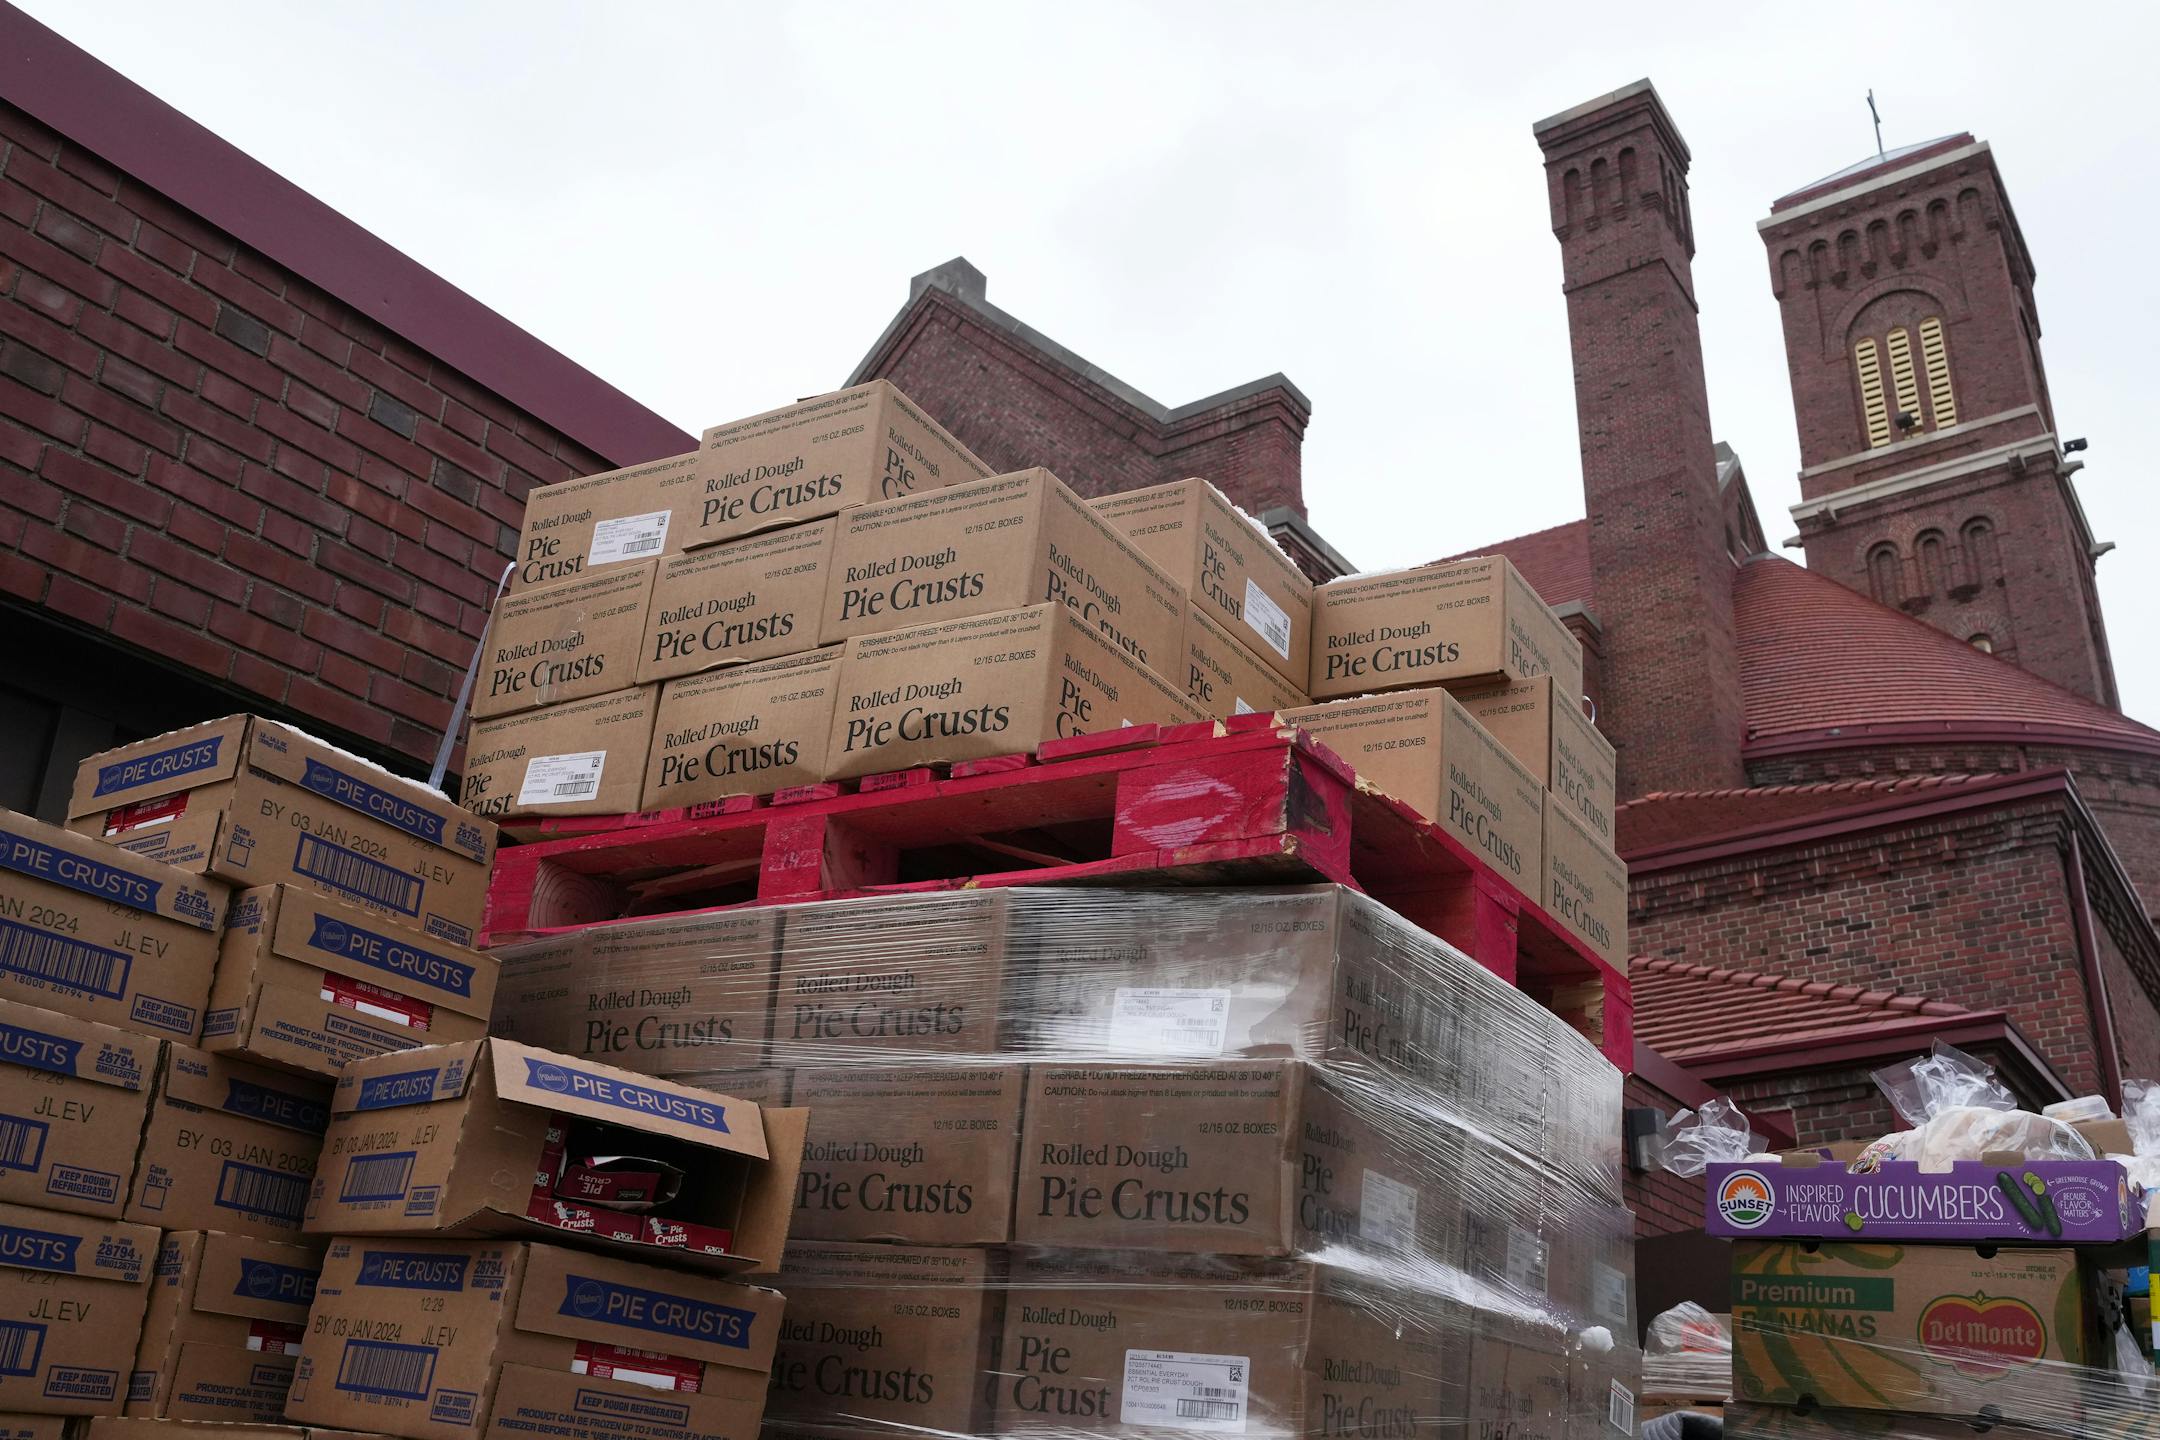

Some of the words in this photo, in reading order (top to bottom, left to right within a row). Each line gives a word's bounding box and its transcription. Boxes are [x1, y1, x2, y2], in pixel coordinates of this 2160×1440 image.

[812, 434, 828, 444] 12/15
[829, 430, 842, 440] OZ.
[842, 424, 864, 438] BOXES
[706, 468, 750, 494] Rolled
[754, 456, 804, 482] Dough
[700, 494, 744, 528] Pie
[750, 473, 843, 514] Crusts
[531, 514, 560, 532] Rolled
[562, 509, 592, 528] Dough
[527, 536, 561, 561] Pie
[1205, 522, 1224, 551] Rolled
[1225, 540, 1245, 568] Dough
[522, 553, 584, 584] Crust
[845, 562, 896, 584] Rolled
[900, 547, 957, 574] Dough
[1203, 542, 1226, 582] Pie
[1416, 572, 1455, 584] REFRIGERATED
[659, 602, 702, 626] Rolled
[706, 592, 756, 618] Dough
[840, 590, 884, 621] Pie
[889, 570, 984, 611] Crusts
[1200, 570, 1242, 622] Crust
[1436, 602, 1454, 612] 12/15
[1455, 600, 1466, 608] OZ.
[1466, 596, 1490, 606] BOXES
[496, 642, 538, 664] Rolled
[540, 632, 584, 656] Dough
[652, 629, 696, 662] Pie
[702, 611, 794, 651] Crusts
[1328, 630, 1375, 649] Rolled
[1380, 620, 1431, 644] Dough
[974, 656, 992, 666] 12/15
[994, 652, 1008, 664] OZ.
[1009, 649, 1036, 662] BOXES
[1326, 653, 1367, 680] Pie
[1372, 641, 1460, 673] Crusts
[490, 668, 528, 698] Pie
[530, 652, 605, 688] Crusts
[849, 690, 901, 712] Rolled
[904, 678, 962, 706] Dough
[664, 728, 706, 750] Rolled
[709, 715, 760, 740] Dough
[843, 720, 892, 752] Pie
[899, 704, 1010, 742] Crusts
[122, 762, 148, 784] PIE
[150, 744, 213, 776] CRUSTS
[469, 751, 496, 769] Rolled
[496, 744, 526, 762] Dough
[658, 754, 700, 788] Pie
[705, 739, 800, 777] Crusts
[465, 772, 492, 800] Pie
[1451, 764, 1476, 798] Rolled
[1478, 791, 1502, 822] Dough
[336, 779, 366, 804] PIE
[368, 792, 437, 834] CRUSTS
[260, 800, 286, 820] BY
[292, 812, 310, 831] 03
[314, 822, 348, 846] JAN
[350, 835, 388, 862] 2024
[1450, 789, 1474, 836] Pie
[1476, 815, 1521, 876] Crusts
[12, 842, 52, 872] PIE
[58, 859, 148, 902] CRUSTS
[414, 860, 454, 886] JLEV
[176, 891, 210, 910] 28794
[30, 906, 80, 934] 2024
[114, 930, 169, 958] JLEV
[350, 934, 383, 958] PIE
[386, 949, 463, 988] CRUSTS
[140, 1000, 160, 1012] KEEP
[163, 1004, 188, 1019] DOUGH
[588, 990, 635, 1011] Rolled
[640, 985, 691, 1010] Dough
[135, 1008, 190, 1030] REFRIGERATED
[584, 1018, 630, 1054] Pie
[634, 1014, 734, 1050] Crusts
[374, 1082, 388, 1102] PIE
[391, 1076, 432, 1100] CRUSTS
[539, 1072, 566, 1083] Pillsbury
[573, 1076, 613, 1100] PIE
[619, 1088, 716, 1124] CRUSTS
[1200, 1124, 1222, 1134] 12/15
[1225, 1123, 1241, 1134] OZ.
[1243, 1123, 1277, 1134] BOXES
[803, 1142, 858, 1162] Rolled
[864, 1142, 924, 1168] Dough
[1040, 1144, 1108, 1166] Rolled
[1116, 1145, 1188, 1174] Dough
[578, 1174, 612, 1186] CRUST
[581, 1183, 604, 1195] PIE
[797, 1172, 852, 1211] Pie
[858, 1174, 973, 1214] Crusts
[1786, 1184, 1844, 1202] INSPIRED
[2056, 1176, 2088, 1184] GREENHOUSE
[2090, 1178, 2109, 1192] GROWN
[1038, 1176, 1102, 1218] Pie
[1112, 1178, 1248, 1224] Crusts
[1720, 1198, 1773, 1213] SUNSET
[1854, 1185, 2004, 1220] CUCUMBERS
[2060, 1200, 2092, 1210] FLAVOR
[2063, 1192, 2086, 1200] BECAUSE
[560, 1217, 595, 1228] Crusts
[576, 1209, 590, 1218] Pie
[1790, 1204, 1840, 1222] FLAVOR
[2064, 1210, 2089, 1218] MATTERS
[656, 1233, 688, 1246] Crusts
[670, 1225, 684, 1234] Pie
[381, 1259, 400, 1280] PIE
[406, 1260, 462, 1284] CRUSTS
[421, 1297, 444, 1312] 12:29
[1742, 1280, 1856, 1304] Premium
[314, 1315, 331, 1334] BY
[333, 1318, 347, 1337] 03
[350, 1320, 372, 1338] JAN
[373, 1322, 402, 1342] 2024
[607, 1292, 646, 1320] PIE
[652, 1301, 742, 1339] CRUSTS
[1022, 1307, 1066, 1326] Rolled
[1070, 1309, 1116, 1330] Dough
[1742, 1311, 1876, 1338] BANANAS
[421, 1324, 458, 1347] JLEV
[820, 1322, 882, 1351] Dough
[1930, 1320, 1962, 1342] Del
[1966, 1322, 2037, 1347] Monte
[1016, 1336, 1070, 1374] Pie
[816, 1354, 934, 1404] Crusts
[582, 1396, 602, 1408] KEEP
[604, 1399, 628, 1412] DOUGH
[630, 1401, 683, 1421] REFRIGERATED
[1013, 1375, 1112, 1419] Crust
